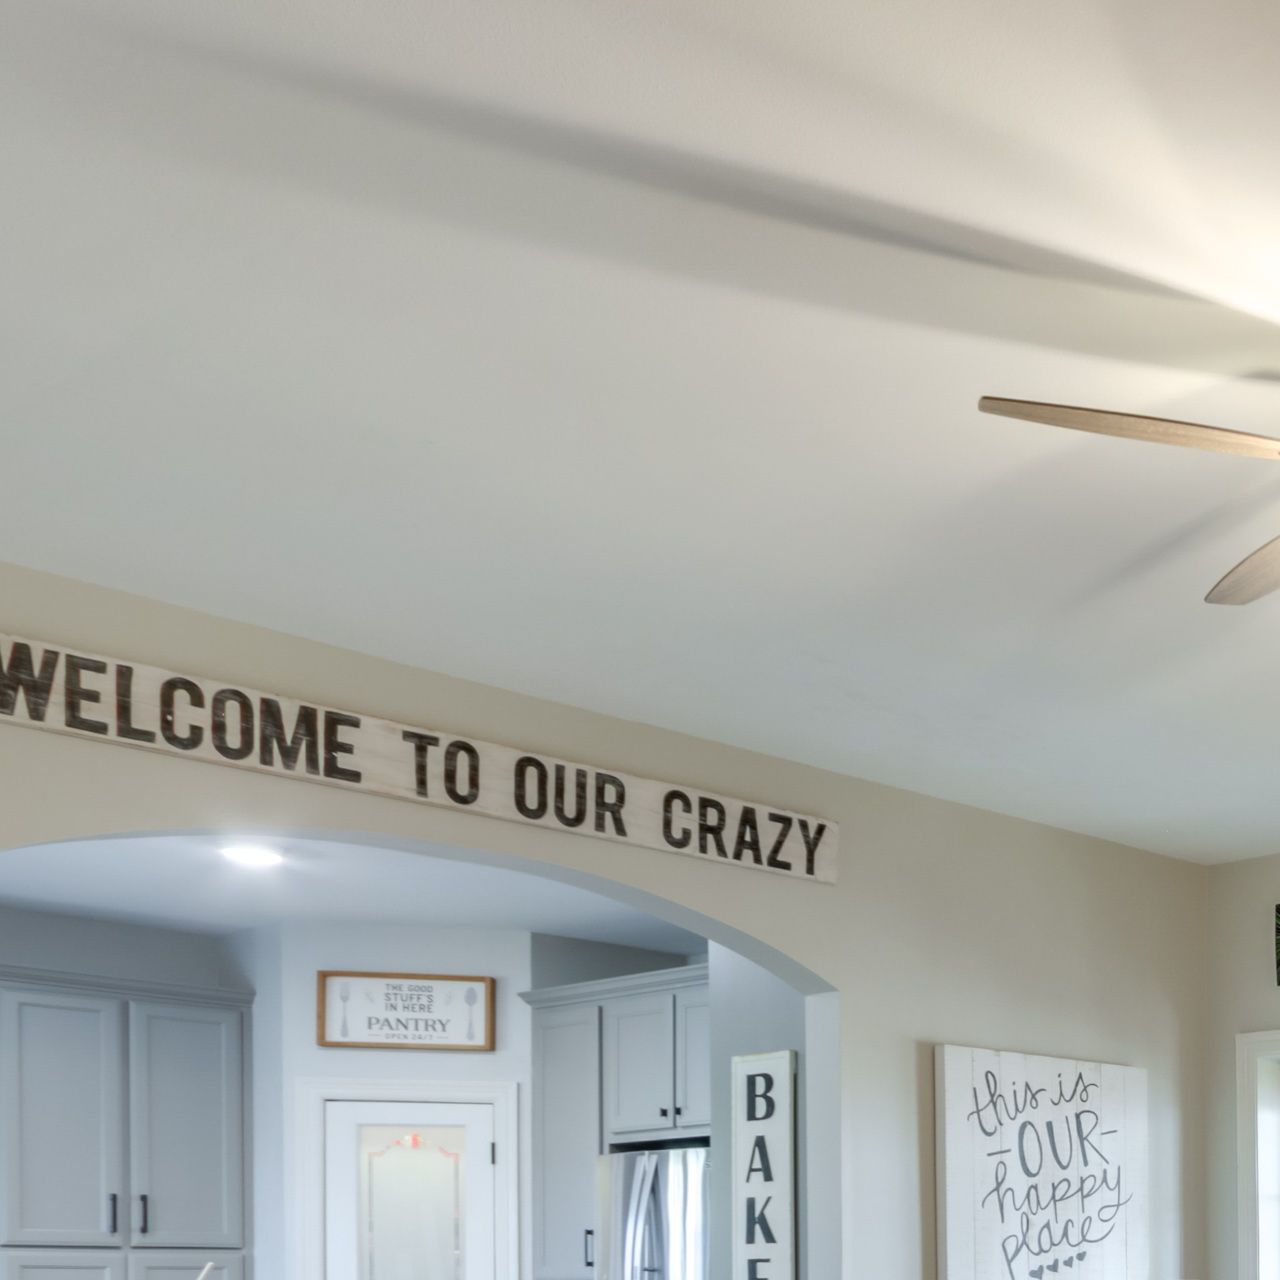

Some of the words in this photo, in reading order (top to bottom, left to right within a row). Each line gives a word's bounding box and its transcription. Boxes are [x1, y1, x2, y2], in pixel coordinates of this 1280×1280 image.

[0, 641, 363, 784] WELCOME
[402, 729, 481, 806] TO
[513, 755, 629, 838] OUR
[662, 788, 828, 876] CRAZY
[384, 992, 434, 1004] STUFF'S
[384, 1002, 398, 1012] IN
[402, 1003, 434, 1014] HERE
[385, 983, 403, 992] THE
[407, 984, 434, 993] GOOD
[367, 1016, 451, 1033] PANTRY
[967, 1070, 1047, 1137] this
[1050, 1071, 1099, 1106] is
[1018, 1109, 1110, 1178] OUR
[981, 1160, 1134, 1224] happy
